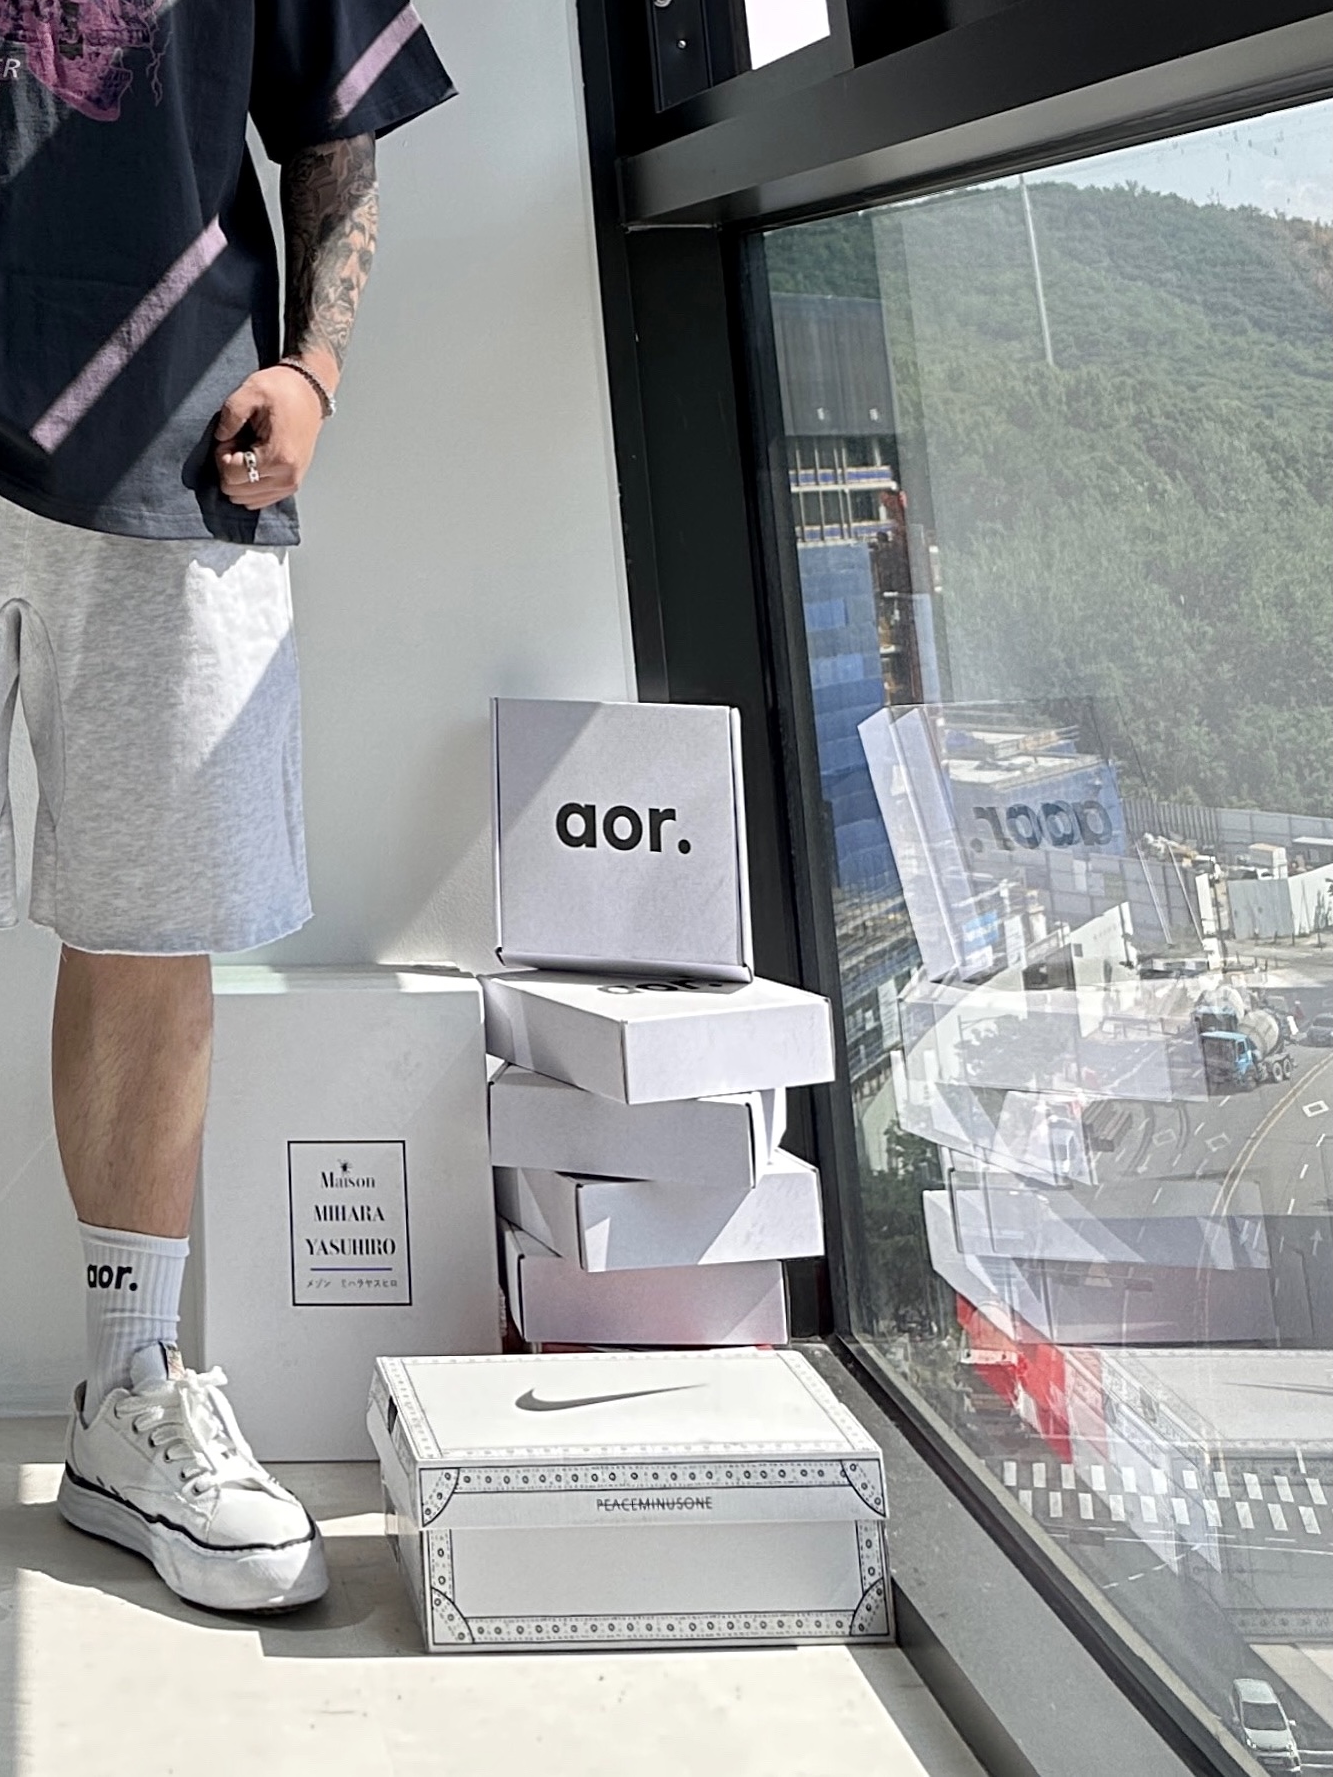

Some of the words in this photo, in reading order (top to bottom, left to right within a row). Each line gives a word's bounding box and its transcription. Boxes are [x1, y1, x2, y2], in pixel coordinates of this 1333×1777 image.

[556, 802, 691, 854] aor.
[321, 1171, 376, 1189] Maison
[314, 1205, 385, 1222] MIHARA
[305, 1238, 396, 1256] YASUHIRO
[87, 1263, 139, 1292] aor.
[596, 1496, 714, 1512] PEACEMINUSONE
